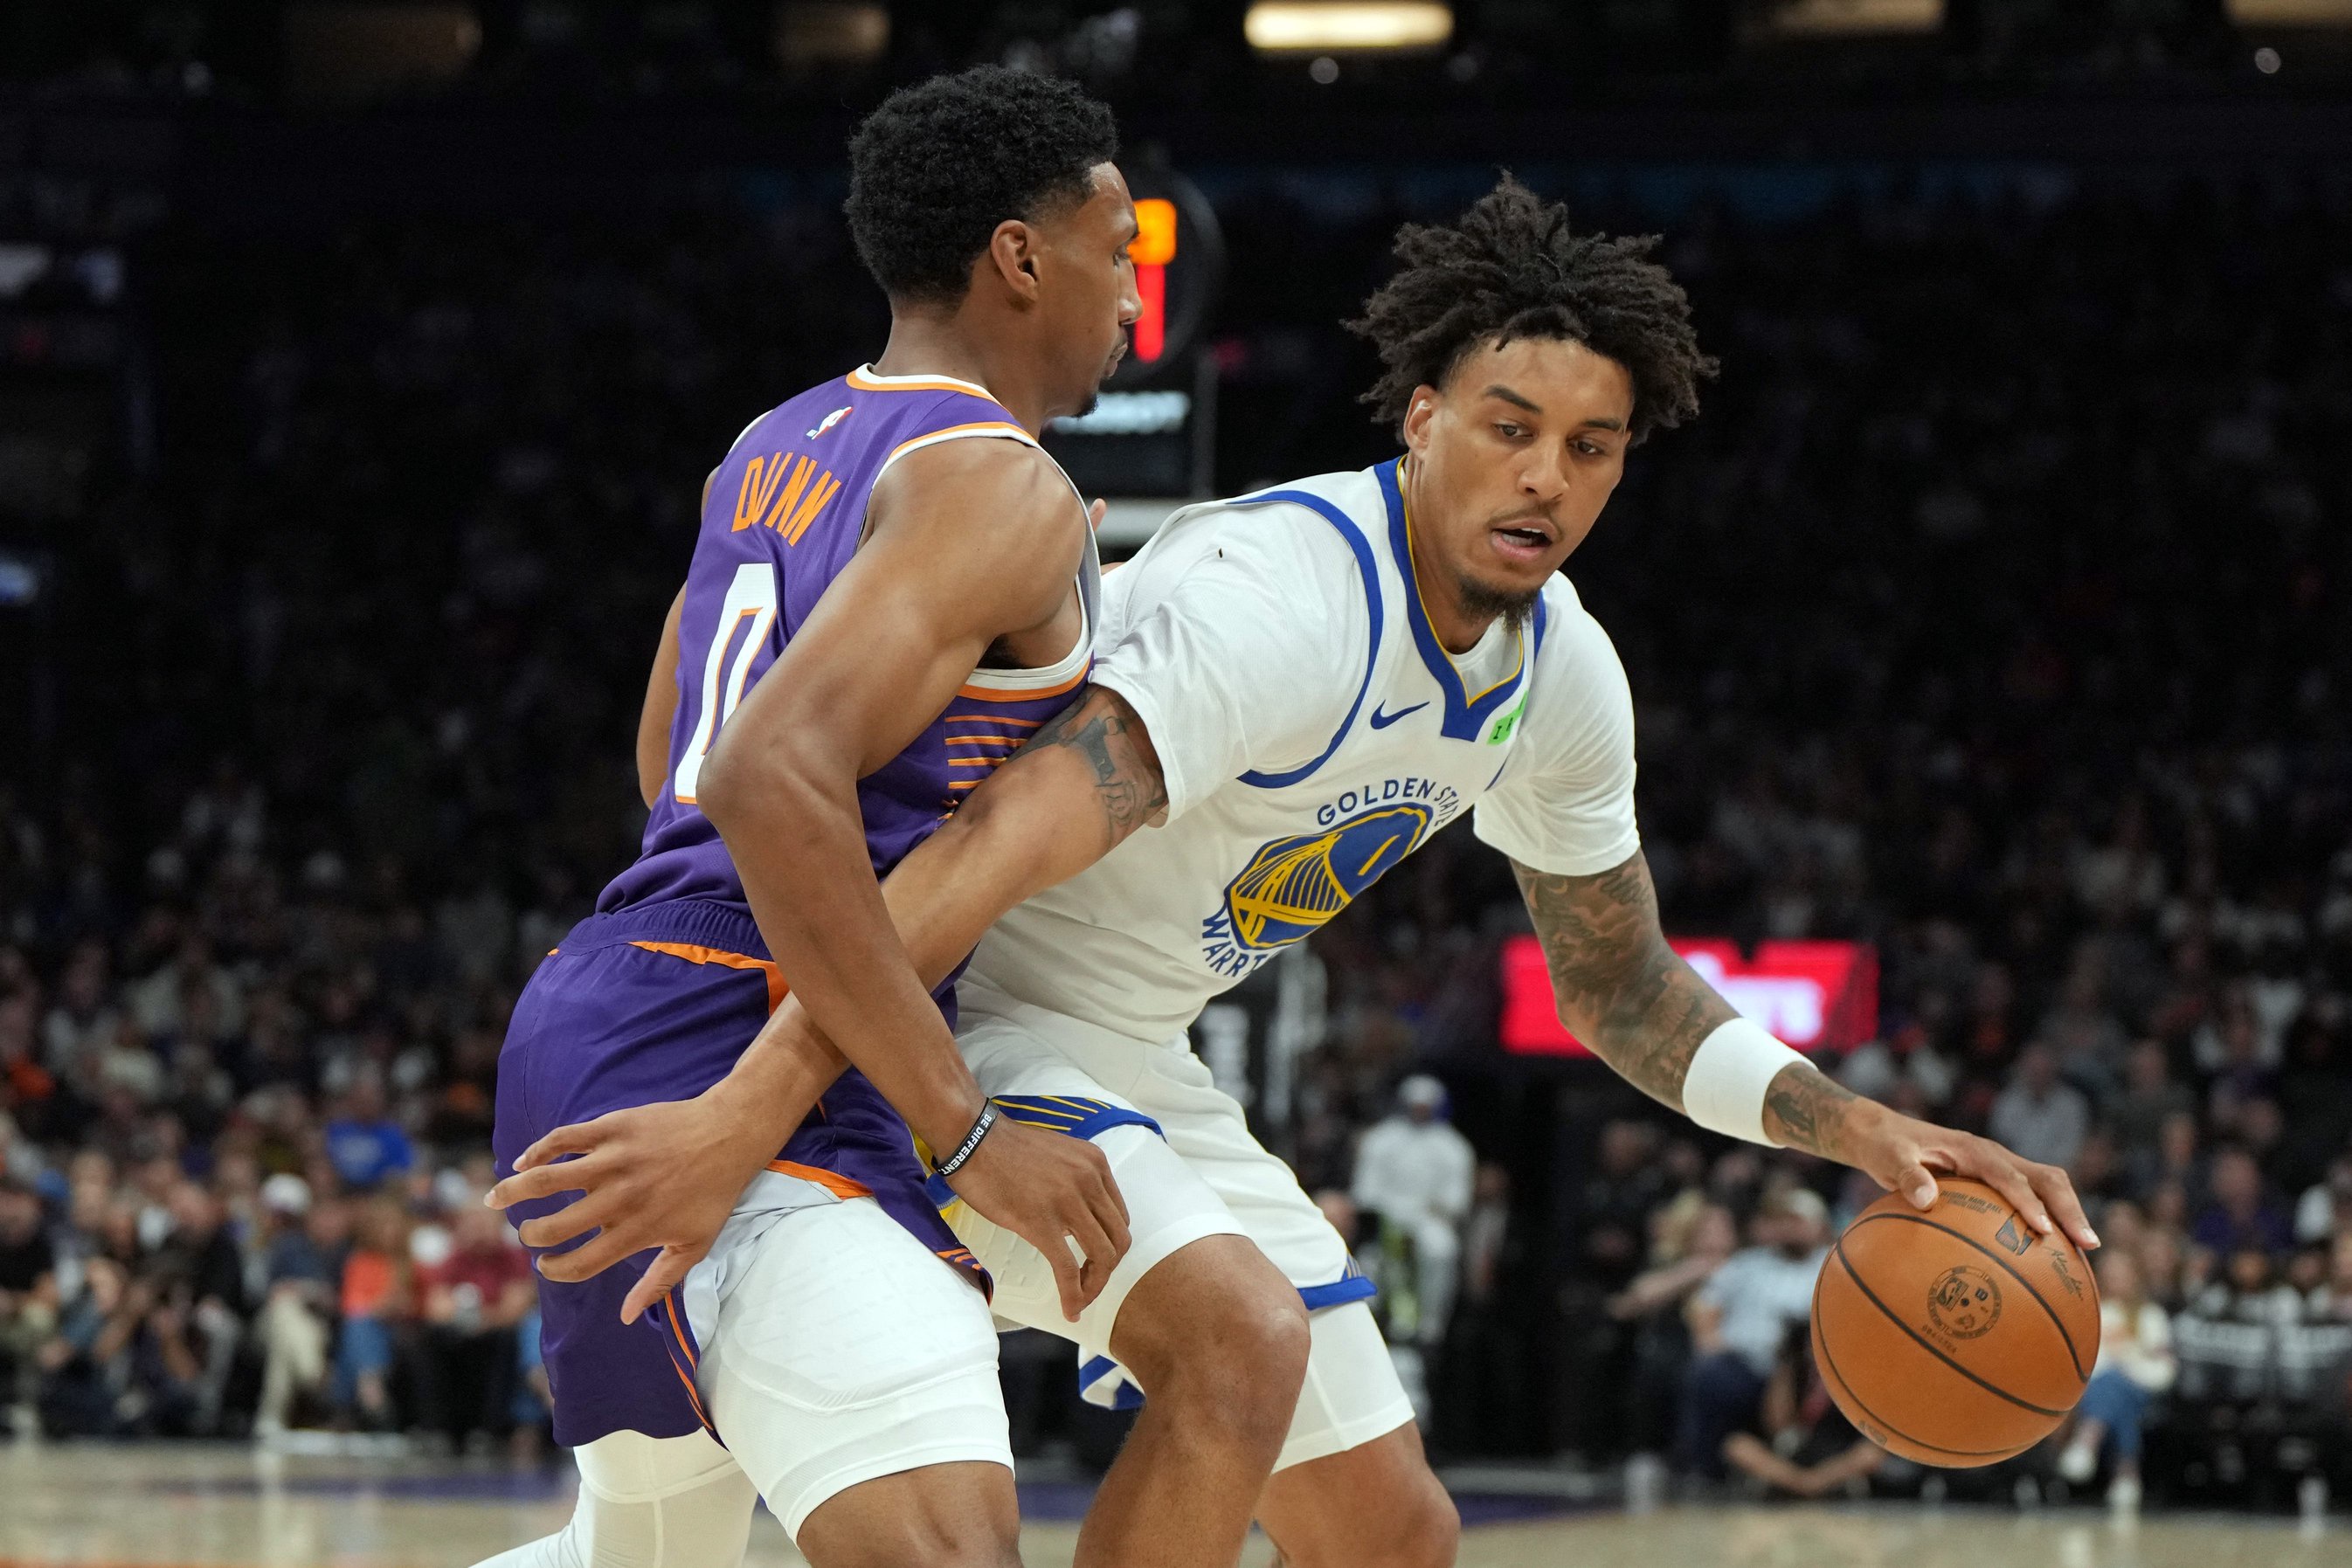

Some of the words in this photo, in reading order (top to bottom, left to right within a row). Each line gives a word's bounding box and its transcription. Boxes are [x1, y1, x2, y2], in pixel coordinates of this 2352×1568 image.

[730, 452, 841, 547] DUNN
[674, 563, 777, 804] 0
[1317, 777, 1437, 826] GOLDEN
[980, 1113, 993, 1129] BE
